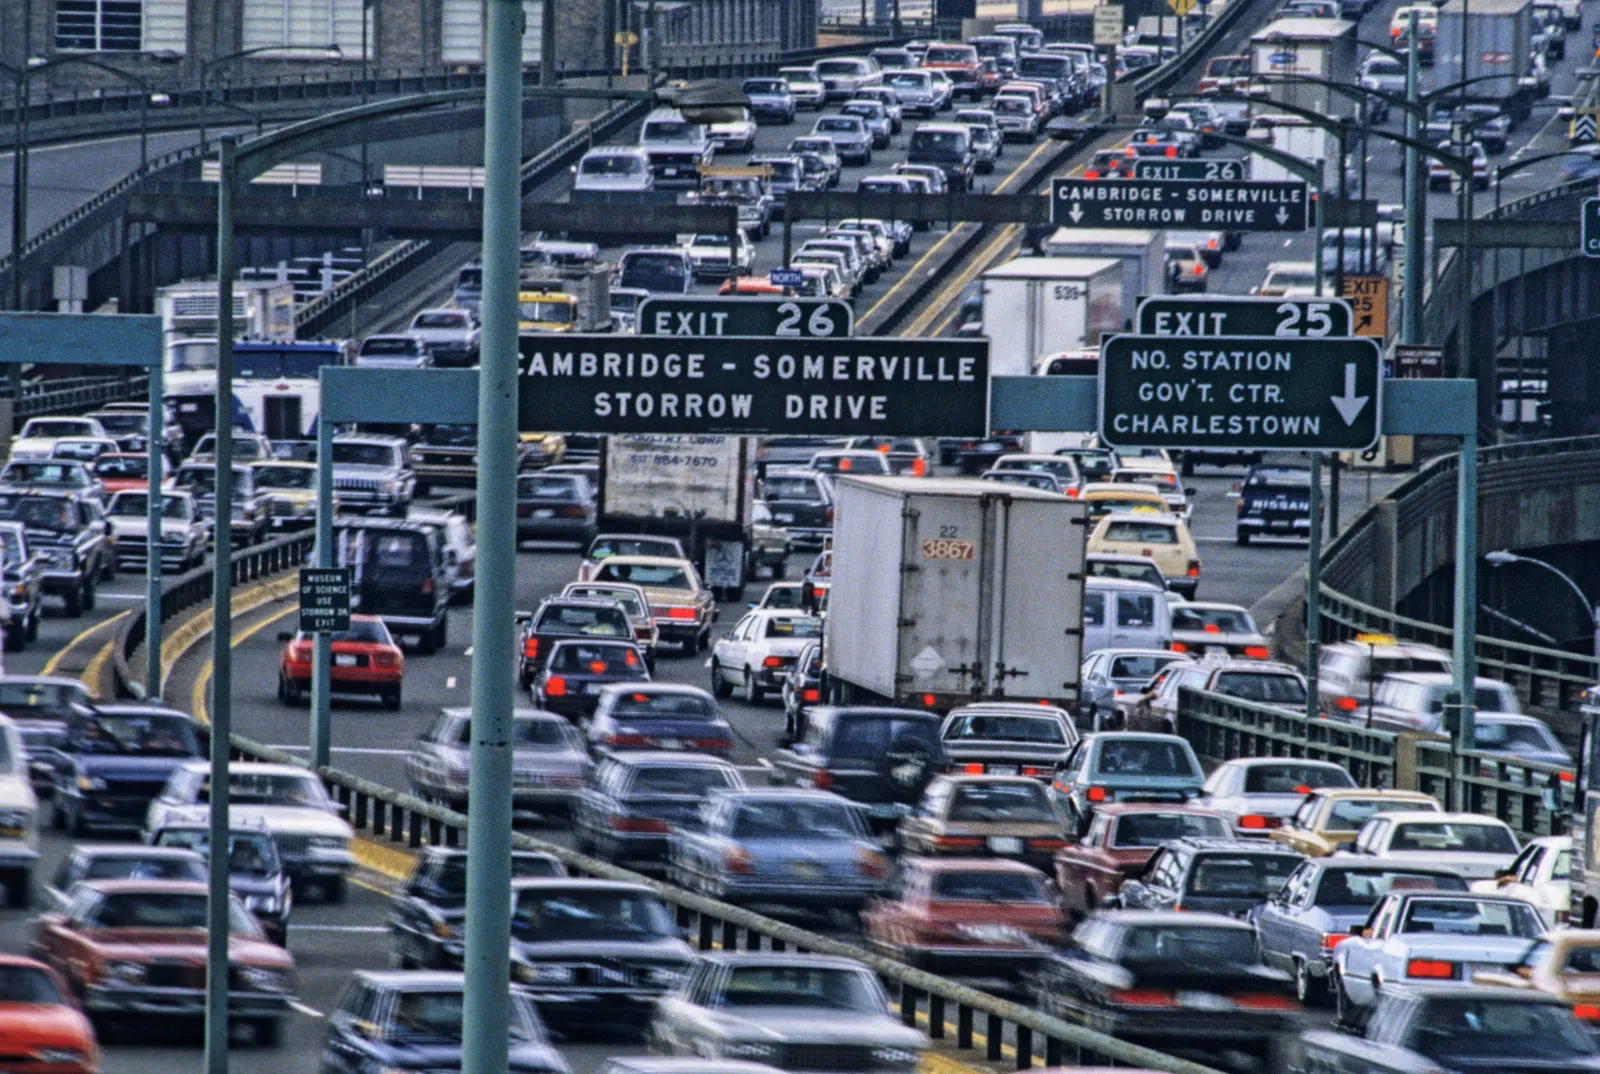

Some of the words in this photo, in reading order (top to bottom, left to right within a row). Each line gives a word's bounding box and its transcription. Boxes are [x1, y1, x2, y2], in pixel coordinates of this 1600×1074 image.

[1142, 166, 1180, 179] EXIT
[1205, 162, 1235, 179] 26
[1059, 187, 1162, 200] CAMBRIDGE
[1187, 188, 1301, 203] SOMERVILLE
[1103, 208, 1186, 222] STORROW
[1202, 209, 1255, 223] DRIVE
[772, 272, 801, 283] NORTH
[655, 311, 728, 336] EXIT
[775, 302, 834, 337] 26
[1154, 312, 1227, 336] EXIT
[1274, 303, 1332, 337] 25
[753, 354, 976, 382] SOMERVILLE
[1131, 351, 1171, 370] NO.
[1182, 351, 1291, 371] STATION
[1138, 378, 1214, 402] GOV'T.
[1229, 384, 1285, 404] CTR.
[594, 392, 753, 419] STORROW
[785, 394, 887, 420] DRIVE
[1113, 414, 1320, 435] CHARLESTOWN
[1252, 499, 1309, 512] NISSAN
[939, 525, 958, 538] 22
[923, 540, 974, 560] 3867
[307, 574, 342, 583] MUSEUM
[315, 585, 347, 594] SCIENCE
[316, 597, 332, 605] USE
[301, 608, 334, 616] STORROW
[315, 619, 335, 627] EXIT
